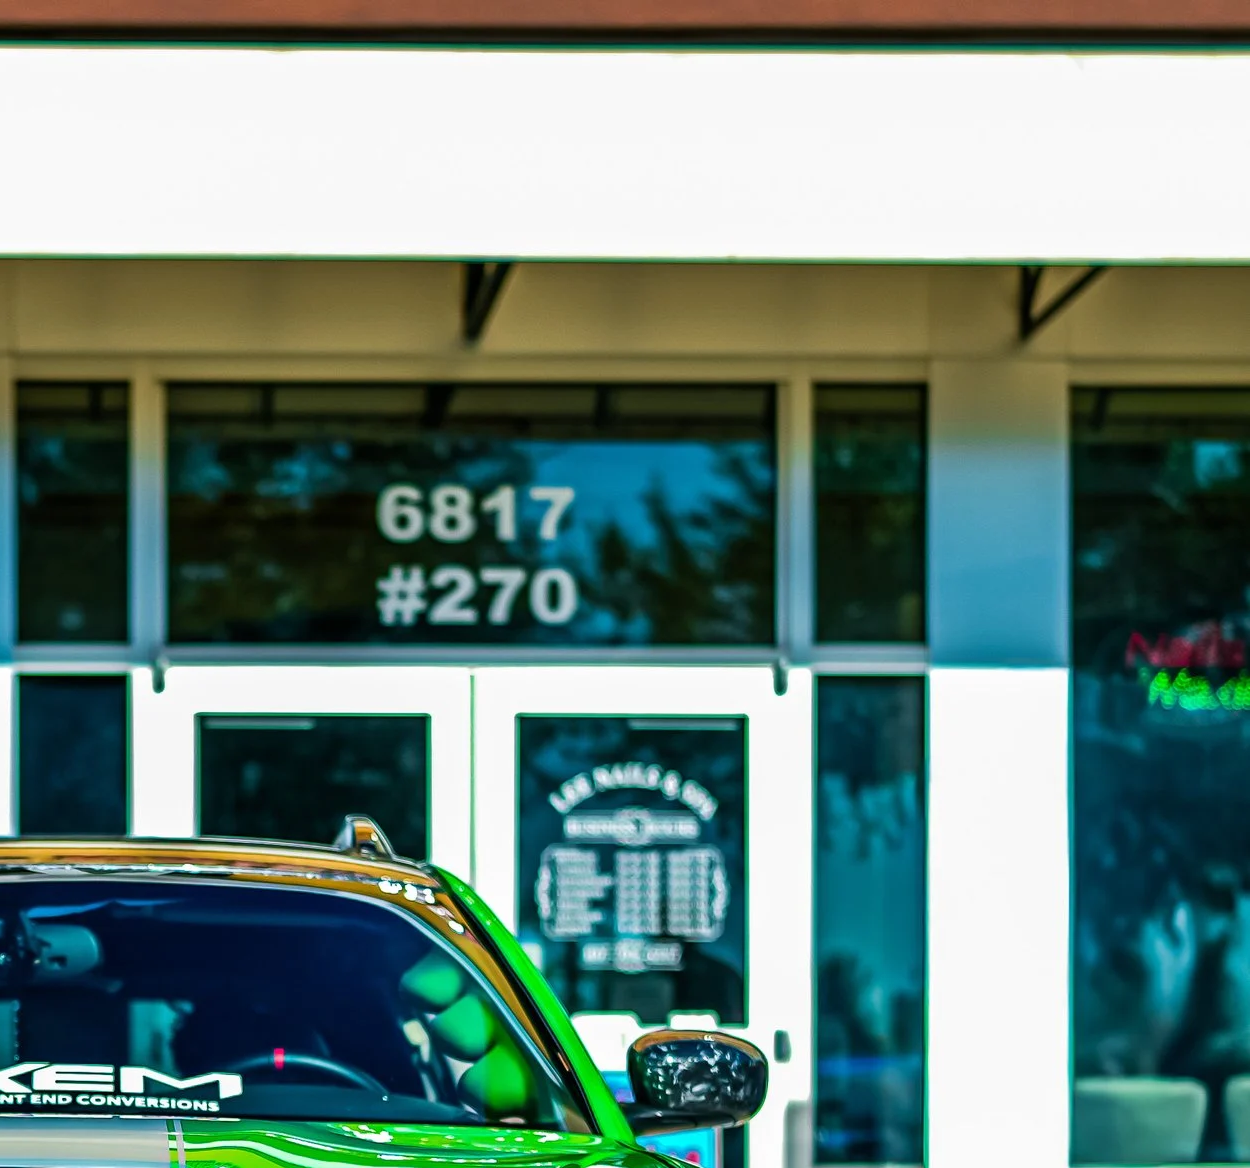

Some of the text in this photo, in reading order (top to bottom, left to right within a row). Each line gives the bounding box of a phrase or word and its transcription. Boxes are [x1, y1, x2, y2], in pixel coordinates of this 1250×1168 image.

[377, 484, 575, 543] 6817
[376, 565, 578, 626] #270
[30, 1093, 73, 1106] END
[75, 1093, 221, 1113] CONVERSIONS
